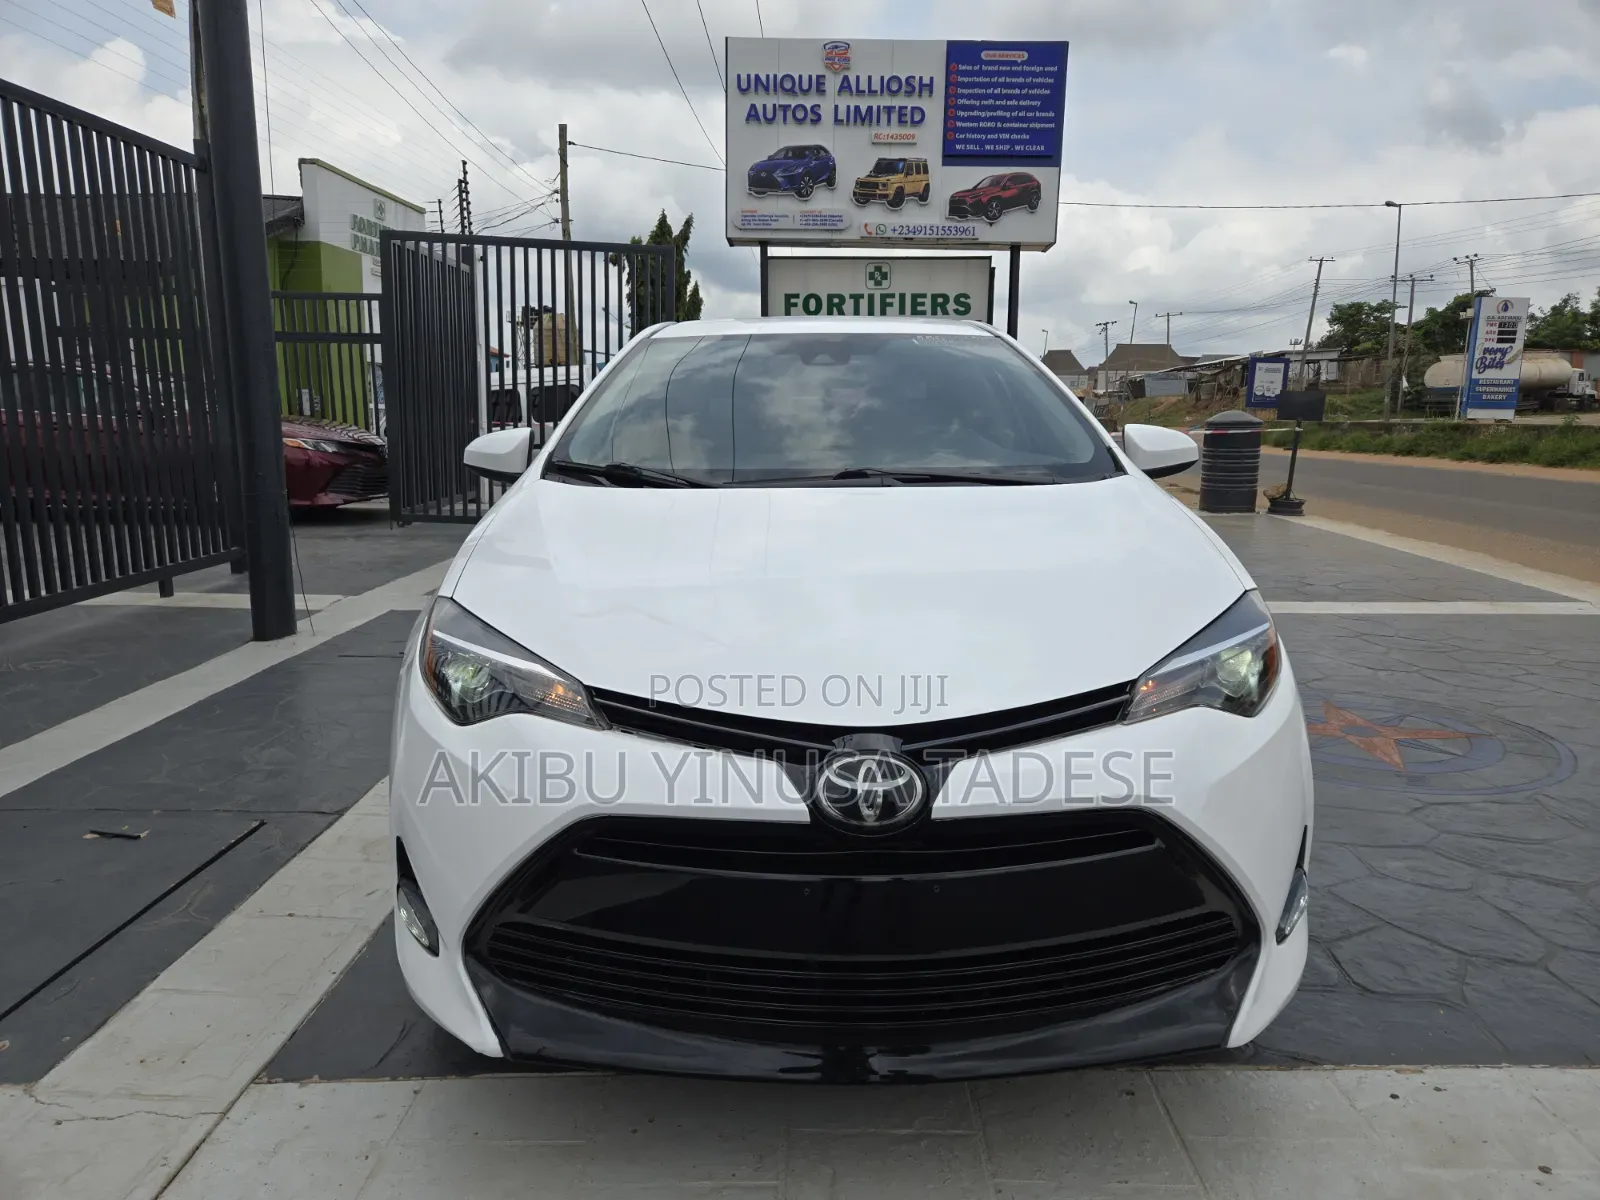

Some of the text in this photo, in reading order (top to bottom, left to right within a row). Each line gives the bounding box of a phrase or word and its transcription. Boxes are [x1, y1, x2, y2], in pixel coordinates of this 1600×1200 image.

[1023, 65, 1043, 73] foreign
[957, 75, 990, 83] Importation
[736, 73, 934, 96] UNIQUE ALLIOSH
[957, 87, 986, 95] Inspection
[957, 98, 980, 106] Offering
[1019, 99, 1041, 107] delivery
[745, 103, 926, 126] AUTOS LIMITED
[1030, 121, 1055, 130] shipment
[873, 132, 916, 141] RC:1435009
[966, 132, 986, 140] history
[890, 224, 976, 237] +2349151553961
[784, 292, 972, 316] FORTIFIERS
[1475, 356, 1505, 374] Bites
